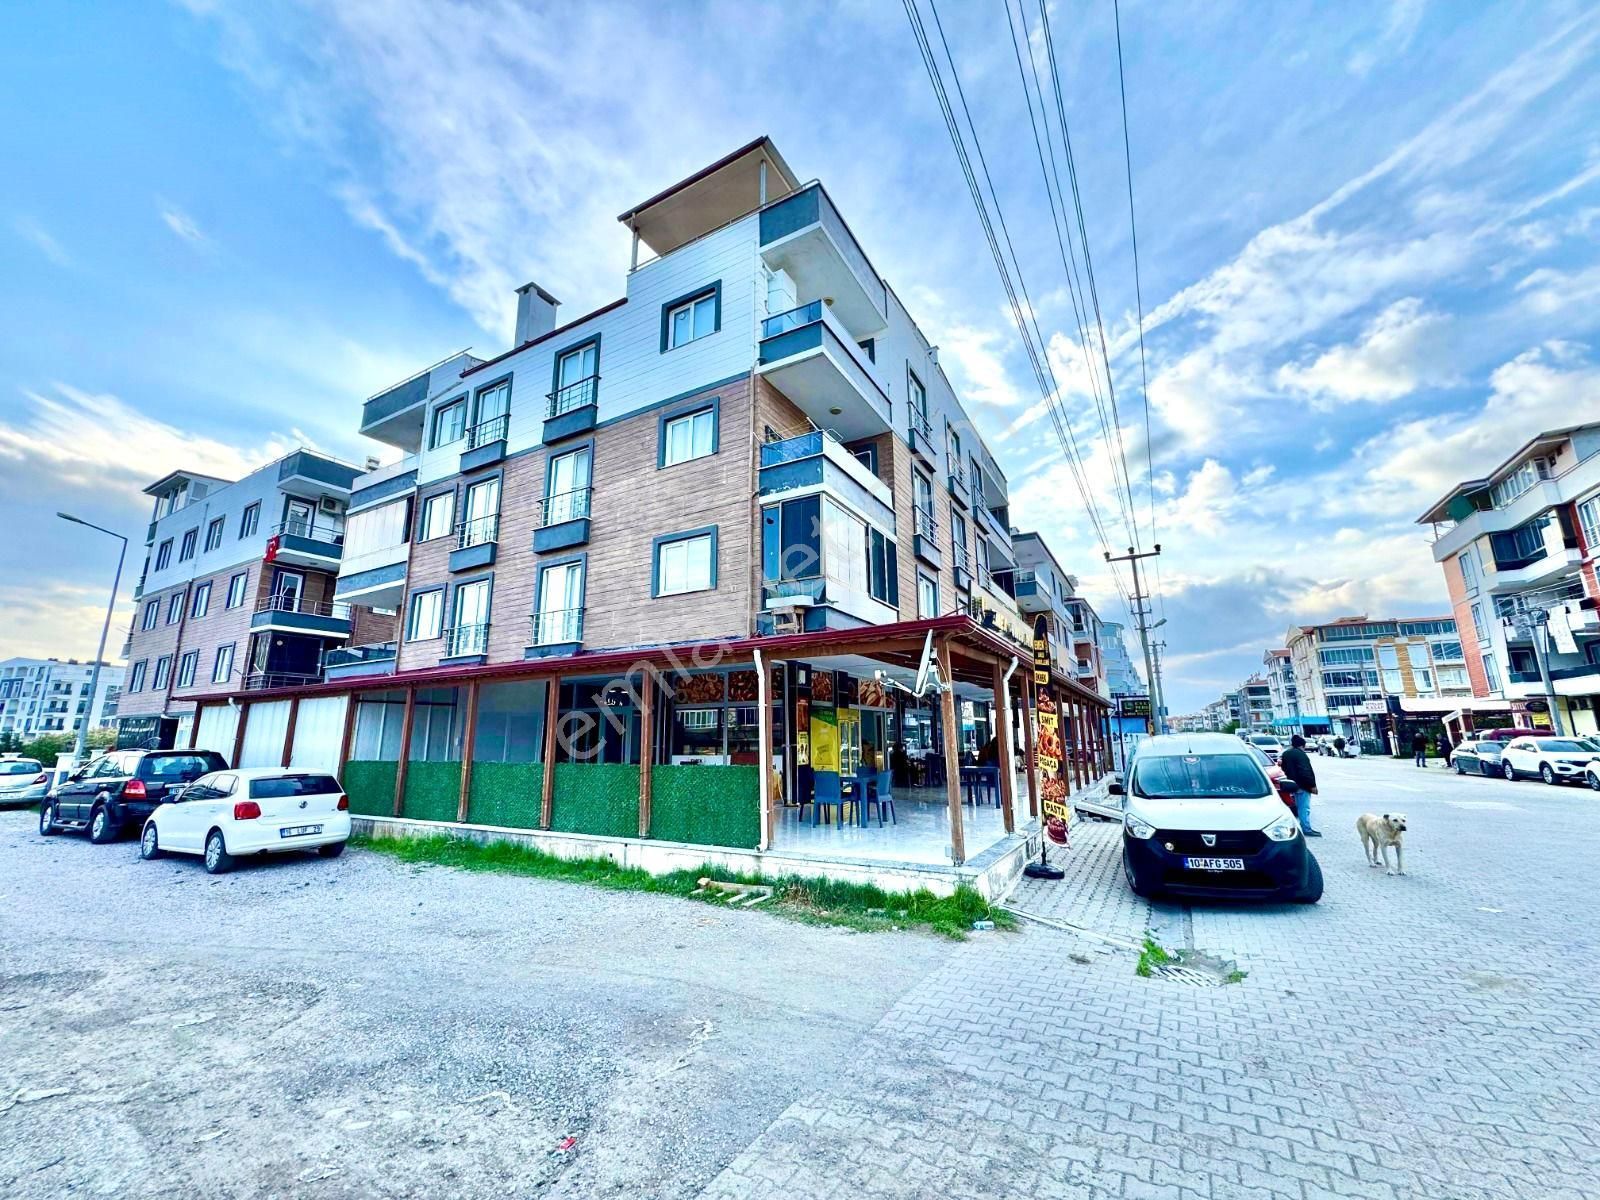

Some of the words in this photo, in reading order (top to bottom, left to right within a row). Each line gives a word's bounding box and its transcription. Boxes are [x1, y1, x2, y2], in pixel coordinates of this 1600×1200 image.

[1045, 802, 1066, 817] PASTA
[1190, 858, 1200, 868] 10
[1203, 859, 1222, 869] AFG
[1223, 859, 1242, 869] 505
